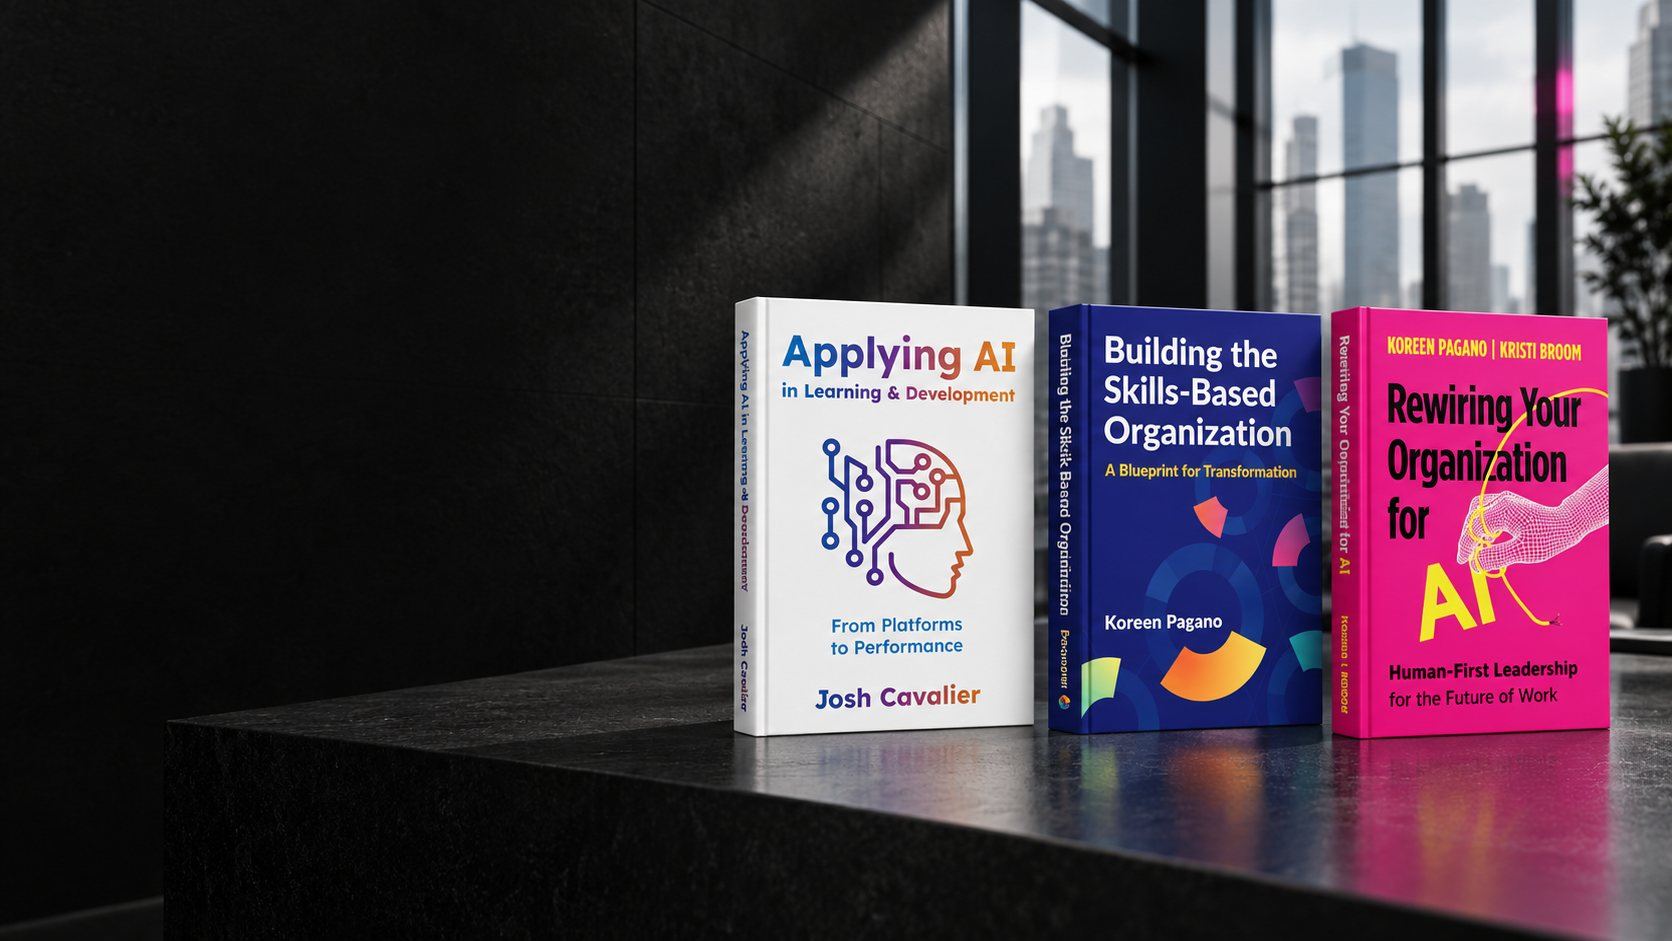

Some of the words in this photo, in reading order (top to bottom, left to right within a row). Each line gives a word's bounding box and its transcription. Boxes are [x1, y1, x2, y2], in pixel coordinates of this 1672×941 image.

[782, 334, 961, 380] Applying
[973, 341, 1016, 372] AI
[1105, 335, 1223, 372] Building
[1231, 340, 1278, 369] the
[1387, 336, 1435, 355] KOREEN
[1439, 338, 1488, 357] PAGANO
[1500, 341, 1537, 360] KRISTI
[1540, 342, 1582, 361] BROOM
[782, 382, 798, 398] in
[805, 383, 881, 403] Learning
[888, 386, 900, 400] &
[906, 385, 1016, 405] Development
[1103, 375, 1276, 407] Skills-Based
[1387, 382, 1512, 434] Rewiring
[1520, 387, 1582, 428] Your
[1104, 415, 1292, 451] Organization
[1105, 464, 1116, 477] A
[1119, 463, 1179, 480] Blueprint
[1181, 464, 1201, 478] for
[1203, 464, 1297, 479] Transformation
[1388, 438, 1567, 488] Organization
[1388, 496, 1430, 540] for
[1419, 560, 1496, 642] AI
[831, 618, 876, 634] From
[882, 617, 963, 632] Platforms
[1105, 614, 1161, 630] Koreen
[1167, 614, 1223, 632] Pagano
[831, 641, 848, 655] to
[854, 639, 963, 655] Performance
[1389, 662, 1490, 680] Human-First
[1494, 660, 1578, 679] Leadership
[815, 688, 871, 709] Josh
[880, 684, 981, 707] Cavalier
[1389, 692, 1412, 707] for
[1416, 690, 1441, 706] the
[1445, 689, 1494, 706] Future
[1498, 688, 1515, 704] of
[1518, 687, 1558, 703] Work
